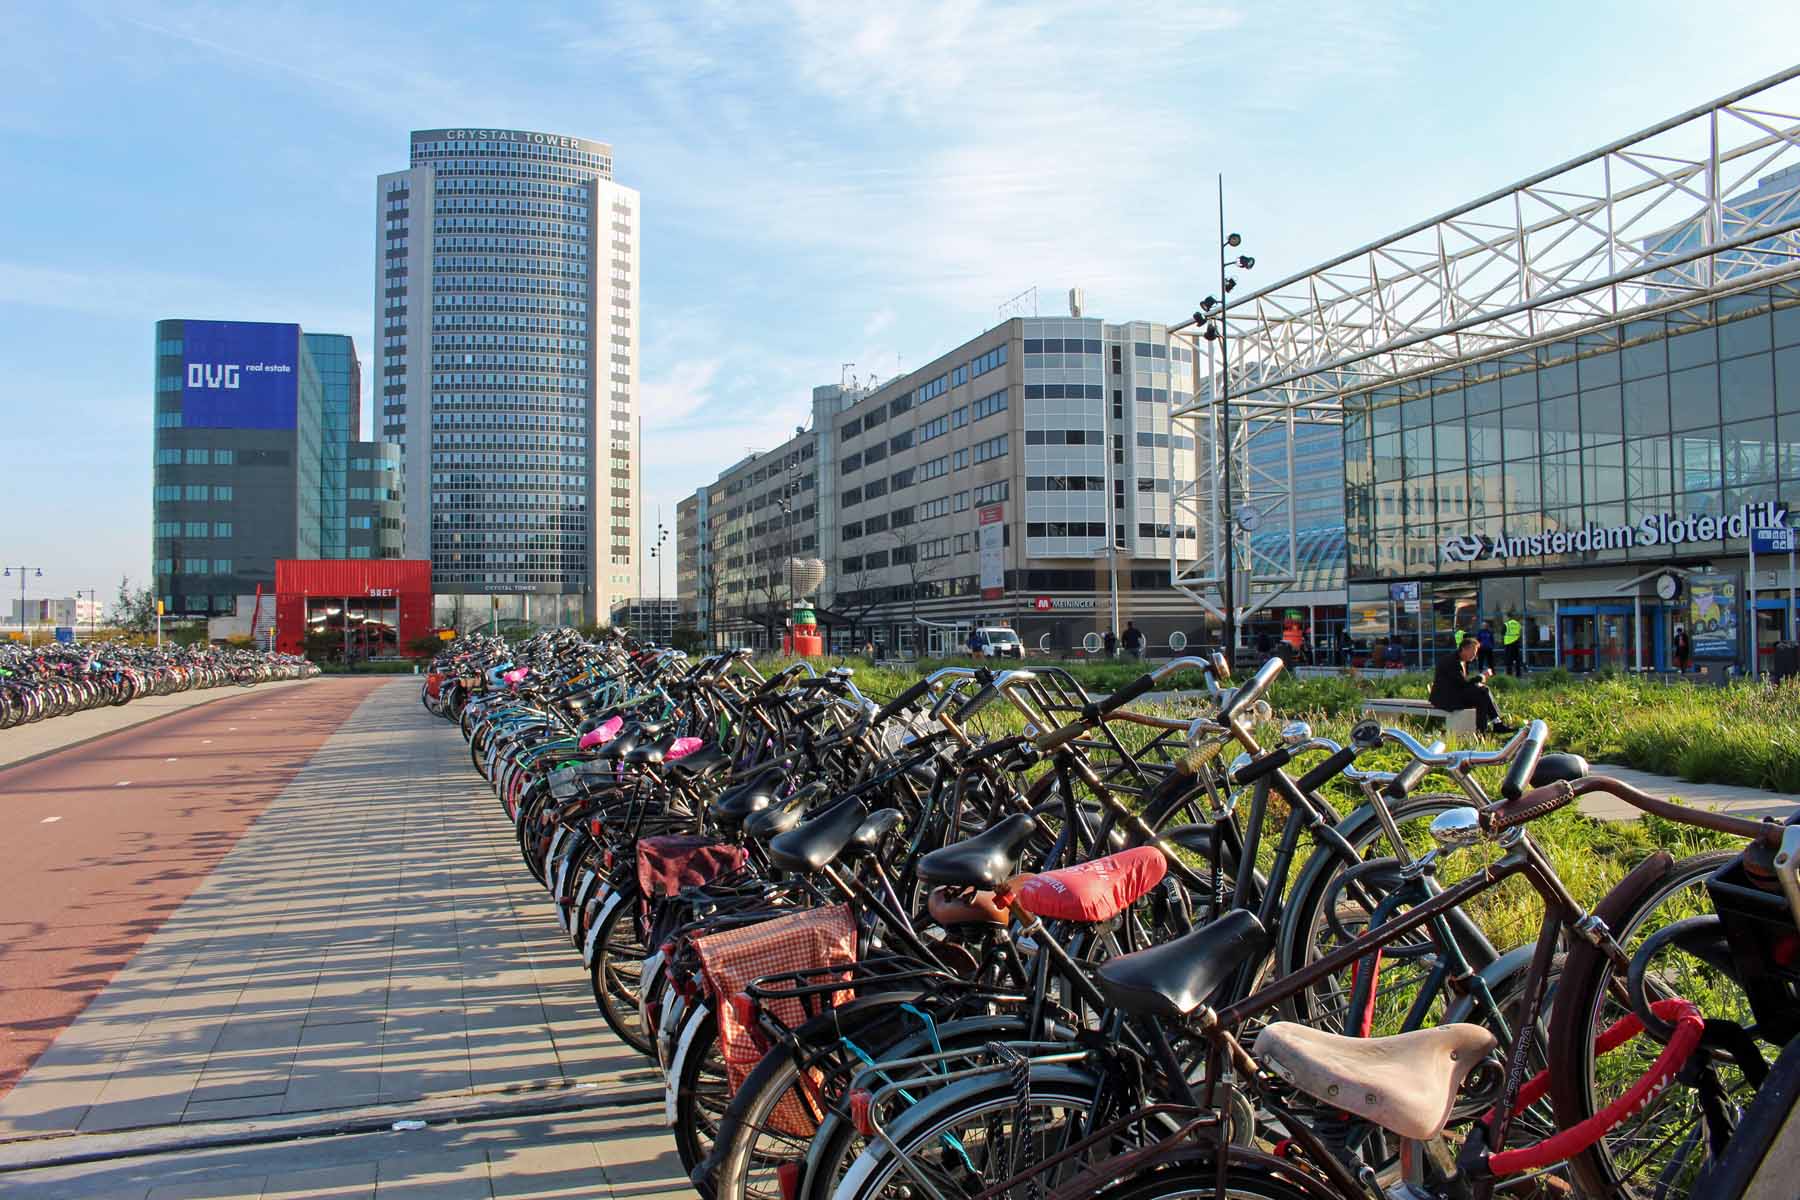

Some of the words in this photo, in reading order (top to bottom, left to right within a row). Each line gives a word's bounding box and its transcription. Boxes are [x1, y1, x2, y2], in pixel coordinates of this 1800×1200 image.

[447, 130, 518, 141] CRYSTAL
[525, 133, 579, 149] TOWER
[187, 363, 240, 389] OVG
[245, 362, 263, 372] real
[264, 364, 291, 373] estate
[1491, 522, 1632, 559] Amsterdam
[1639, 501, 1786, 546] Sloterdijk
[370, 588, 393, 597] BRET
[1052, 599, 1096, 608] MEININGER
[1215, 867, 1224, 904] BASIC
